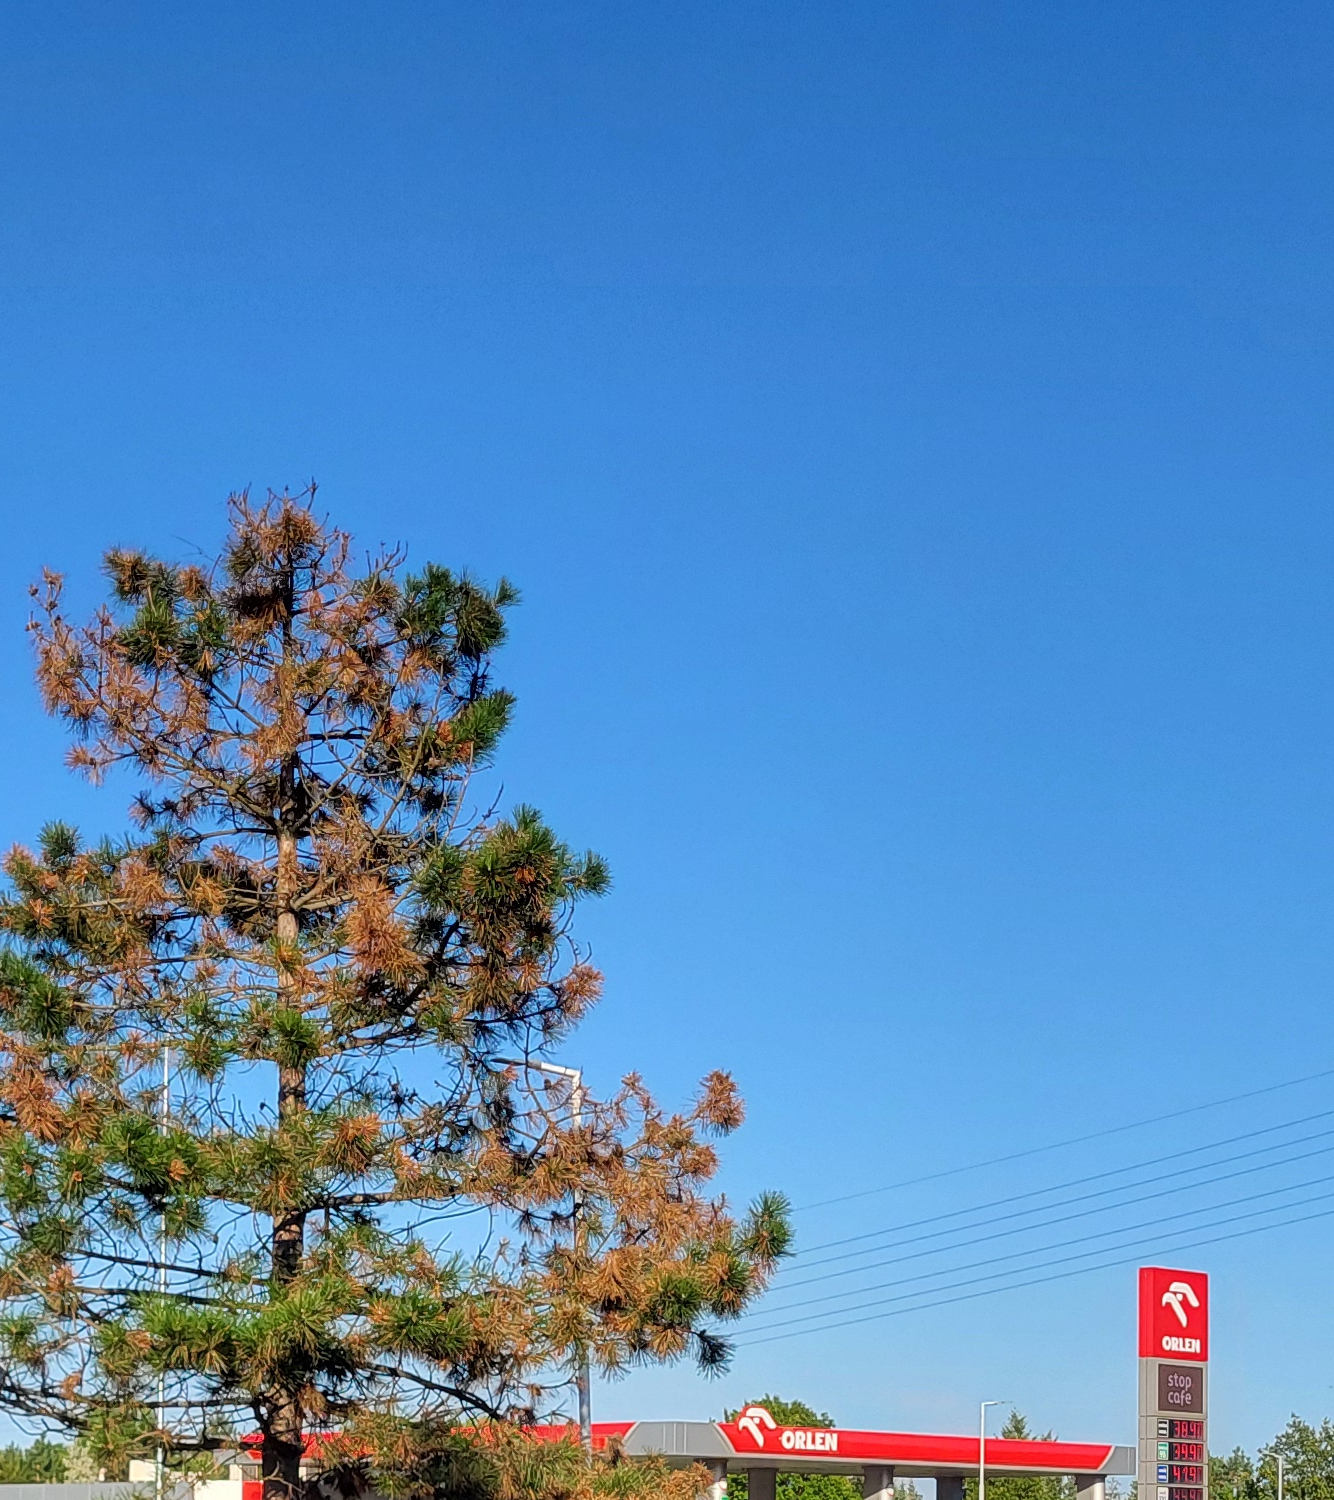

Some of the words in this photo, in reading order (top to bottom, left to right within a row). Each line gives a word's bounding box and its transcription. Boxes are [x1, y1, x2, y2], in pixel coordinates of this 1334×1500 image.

[1161, 1335, 1201, 1354] ORLEN
[1167, 1372, 1192, 1392] stop
[1167, 1389, 1192, 1407] cafe
[781, 1430, 838, 1451] ORLEN
